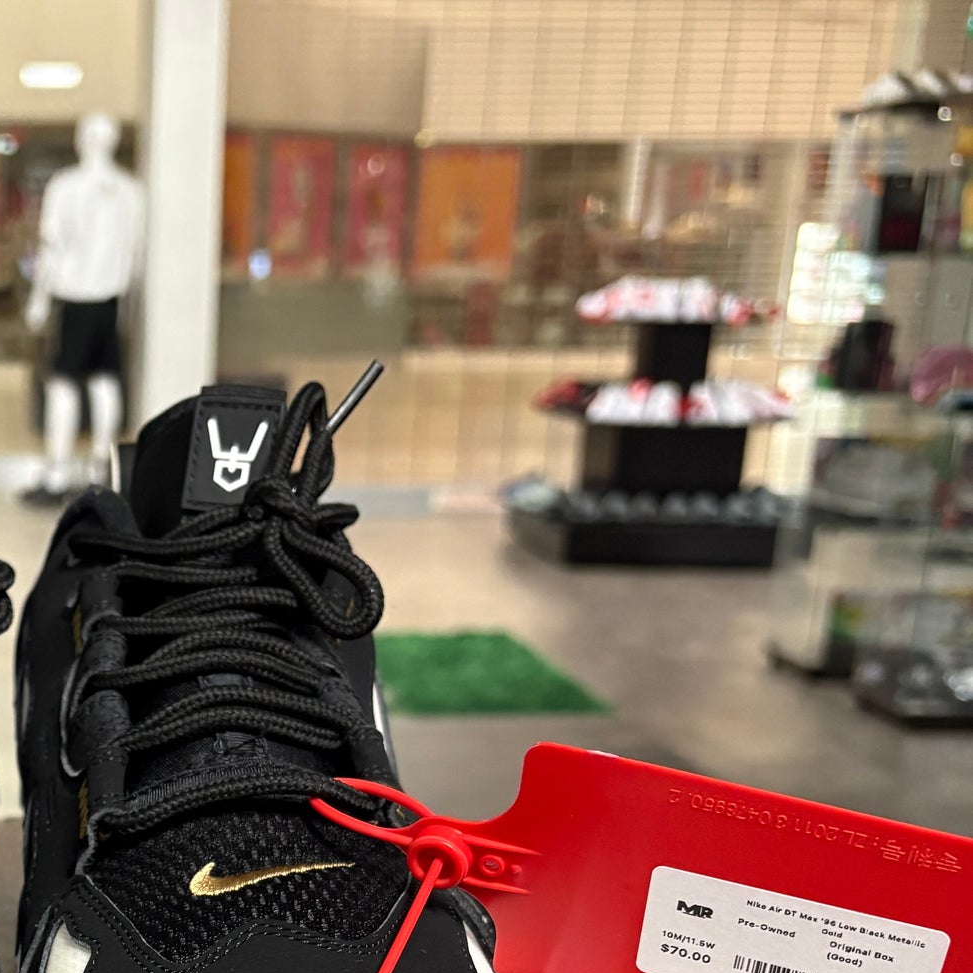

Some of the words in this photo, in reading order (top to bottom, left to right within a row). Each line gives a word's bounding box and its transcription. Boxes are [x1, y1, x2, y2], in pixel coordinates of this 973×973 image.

[676, 900, 714, 919] MR
[746, 900, 767, 910] Nike
[768, 905, 783, 913] Air
[784, 909, 798, 917] DT
[799, 912, 818, 923] Max
[838, 922, 857, 932] Low
[859, 927, 885, 939] Black
[738, 918, 796, 938] Pre-Owned
[662, 930, 716, 949] 10M/11.5W
[660, 943, 711, 964] $70.00
[826, 952, 863, 968] (Good)
[829, 941, 872, 957] Original
[874, 952, 894, 963] Box
